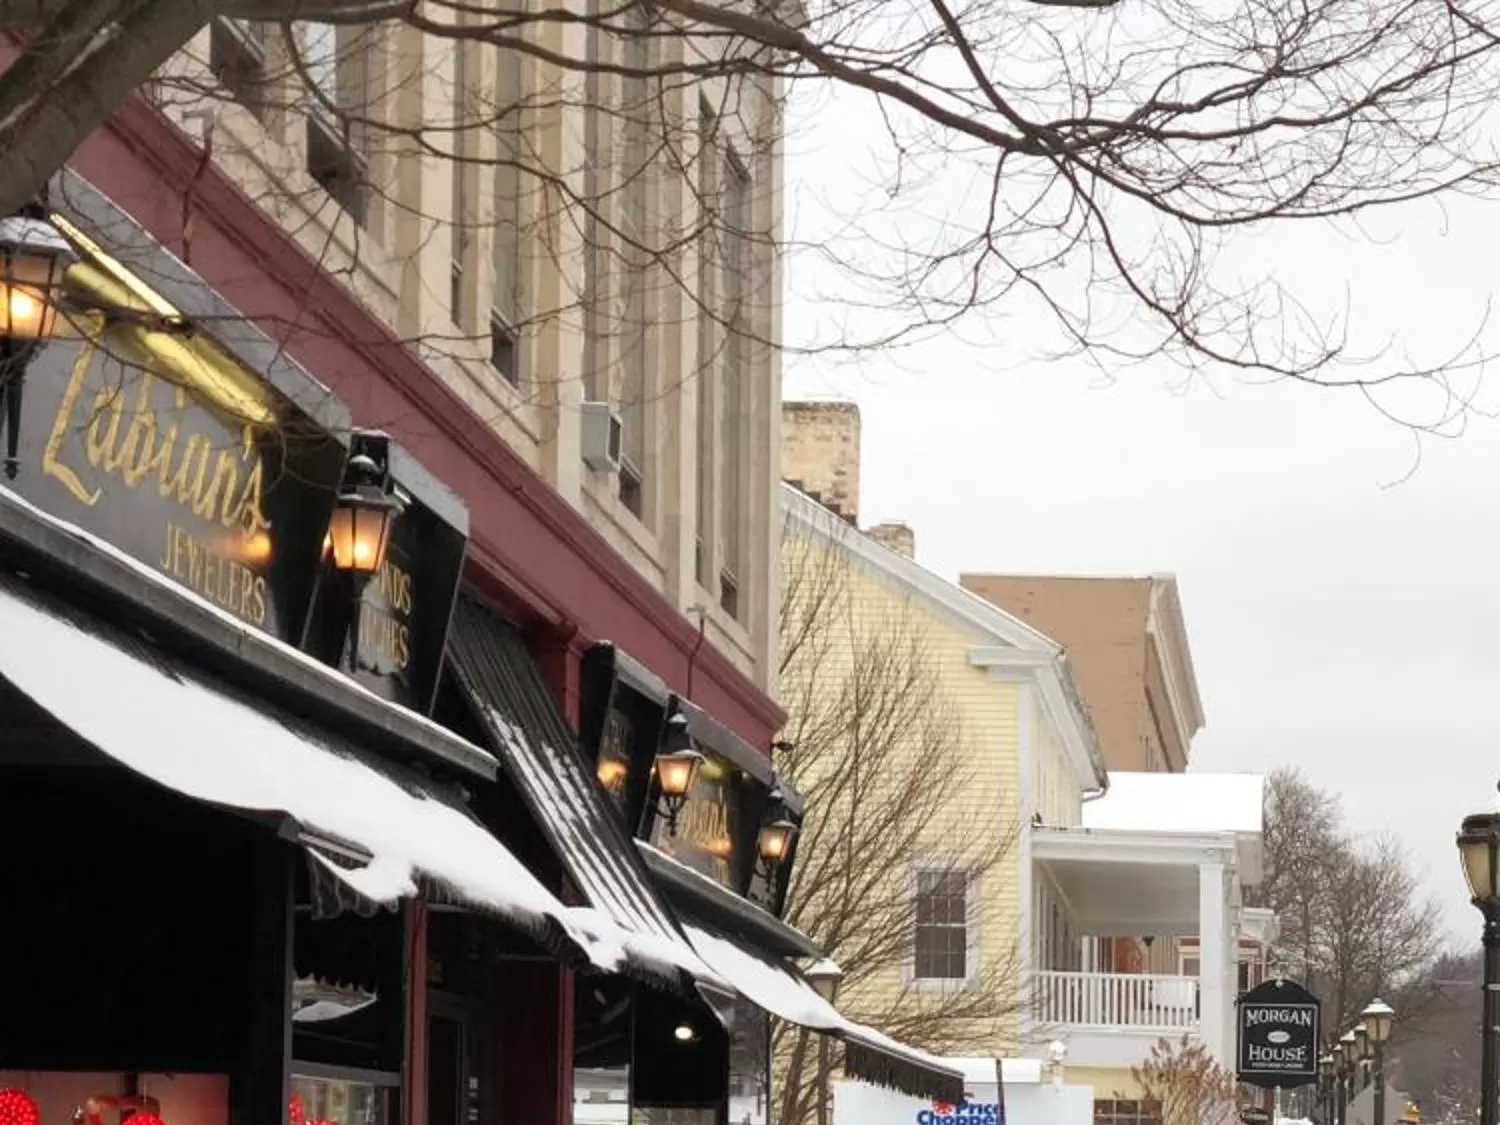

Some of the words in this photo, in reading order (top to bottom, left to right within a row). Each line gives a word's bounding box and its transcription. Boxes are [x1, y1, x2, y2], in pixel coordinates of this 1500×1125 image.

[160, 521, 266, 626] JEWELERS
[1246, 1008, 1312, 1027] MORGAN
[1248, 1043, 1307, 1062] HOUSE
